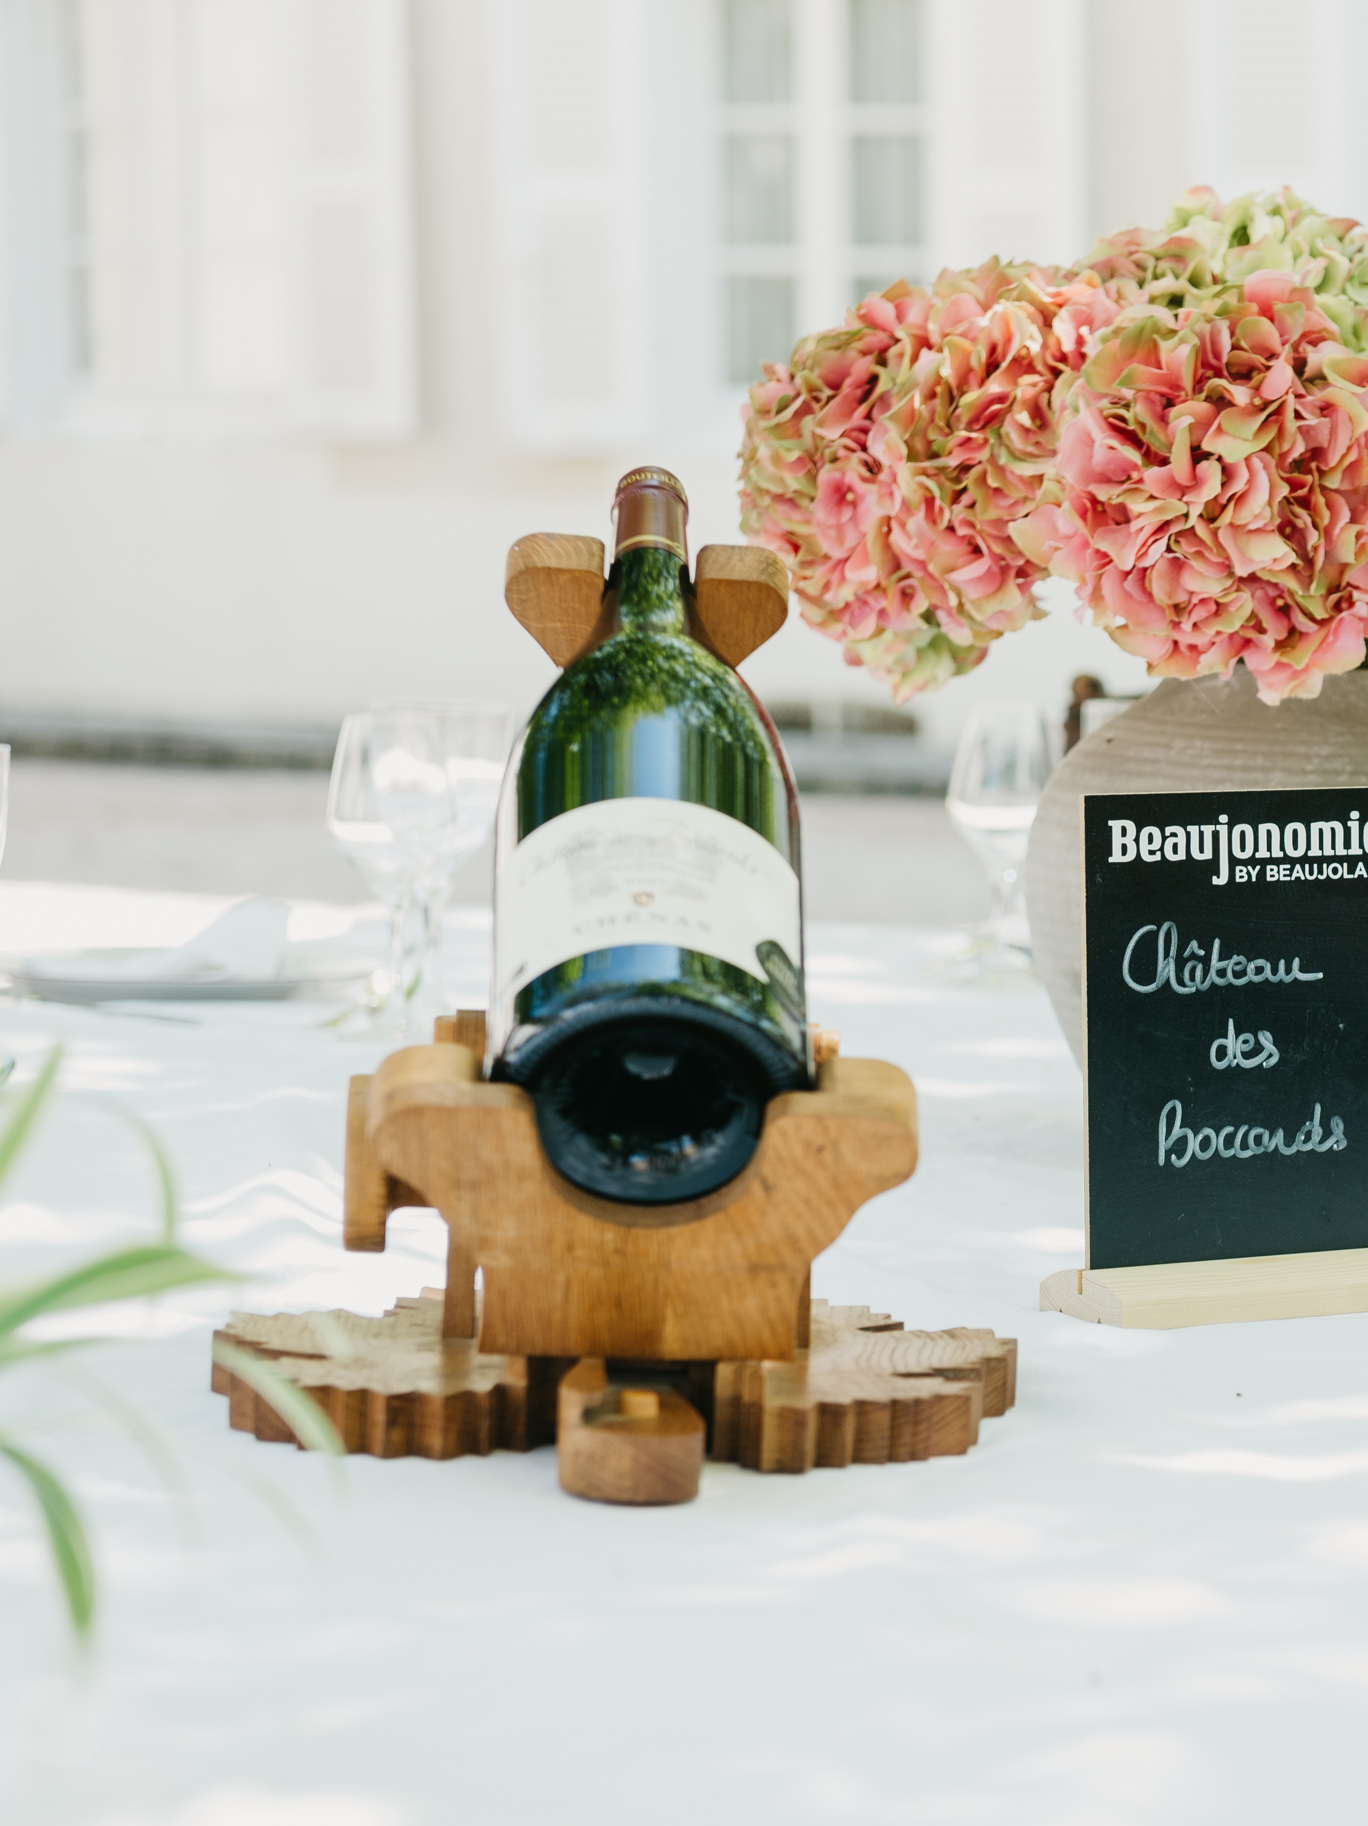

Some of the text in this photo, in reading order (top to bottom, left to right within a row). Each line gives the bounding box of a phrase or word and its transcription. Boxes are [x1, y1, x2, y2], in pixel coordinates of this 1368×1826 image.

[1235, 866, 1260, 883] BY
[1122, 921, 1324, 995] Château
[1209, 1017, 1281, 1070] des
[1157, 1098, 1348, 1168] Boccards
